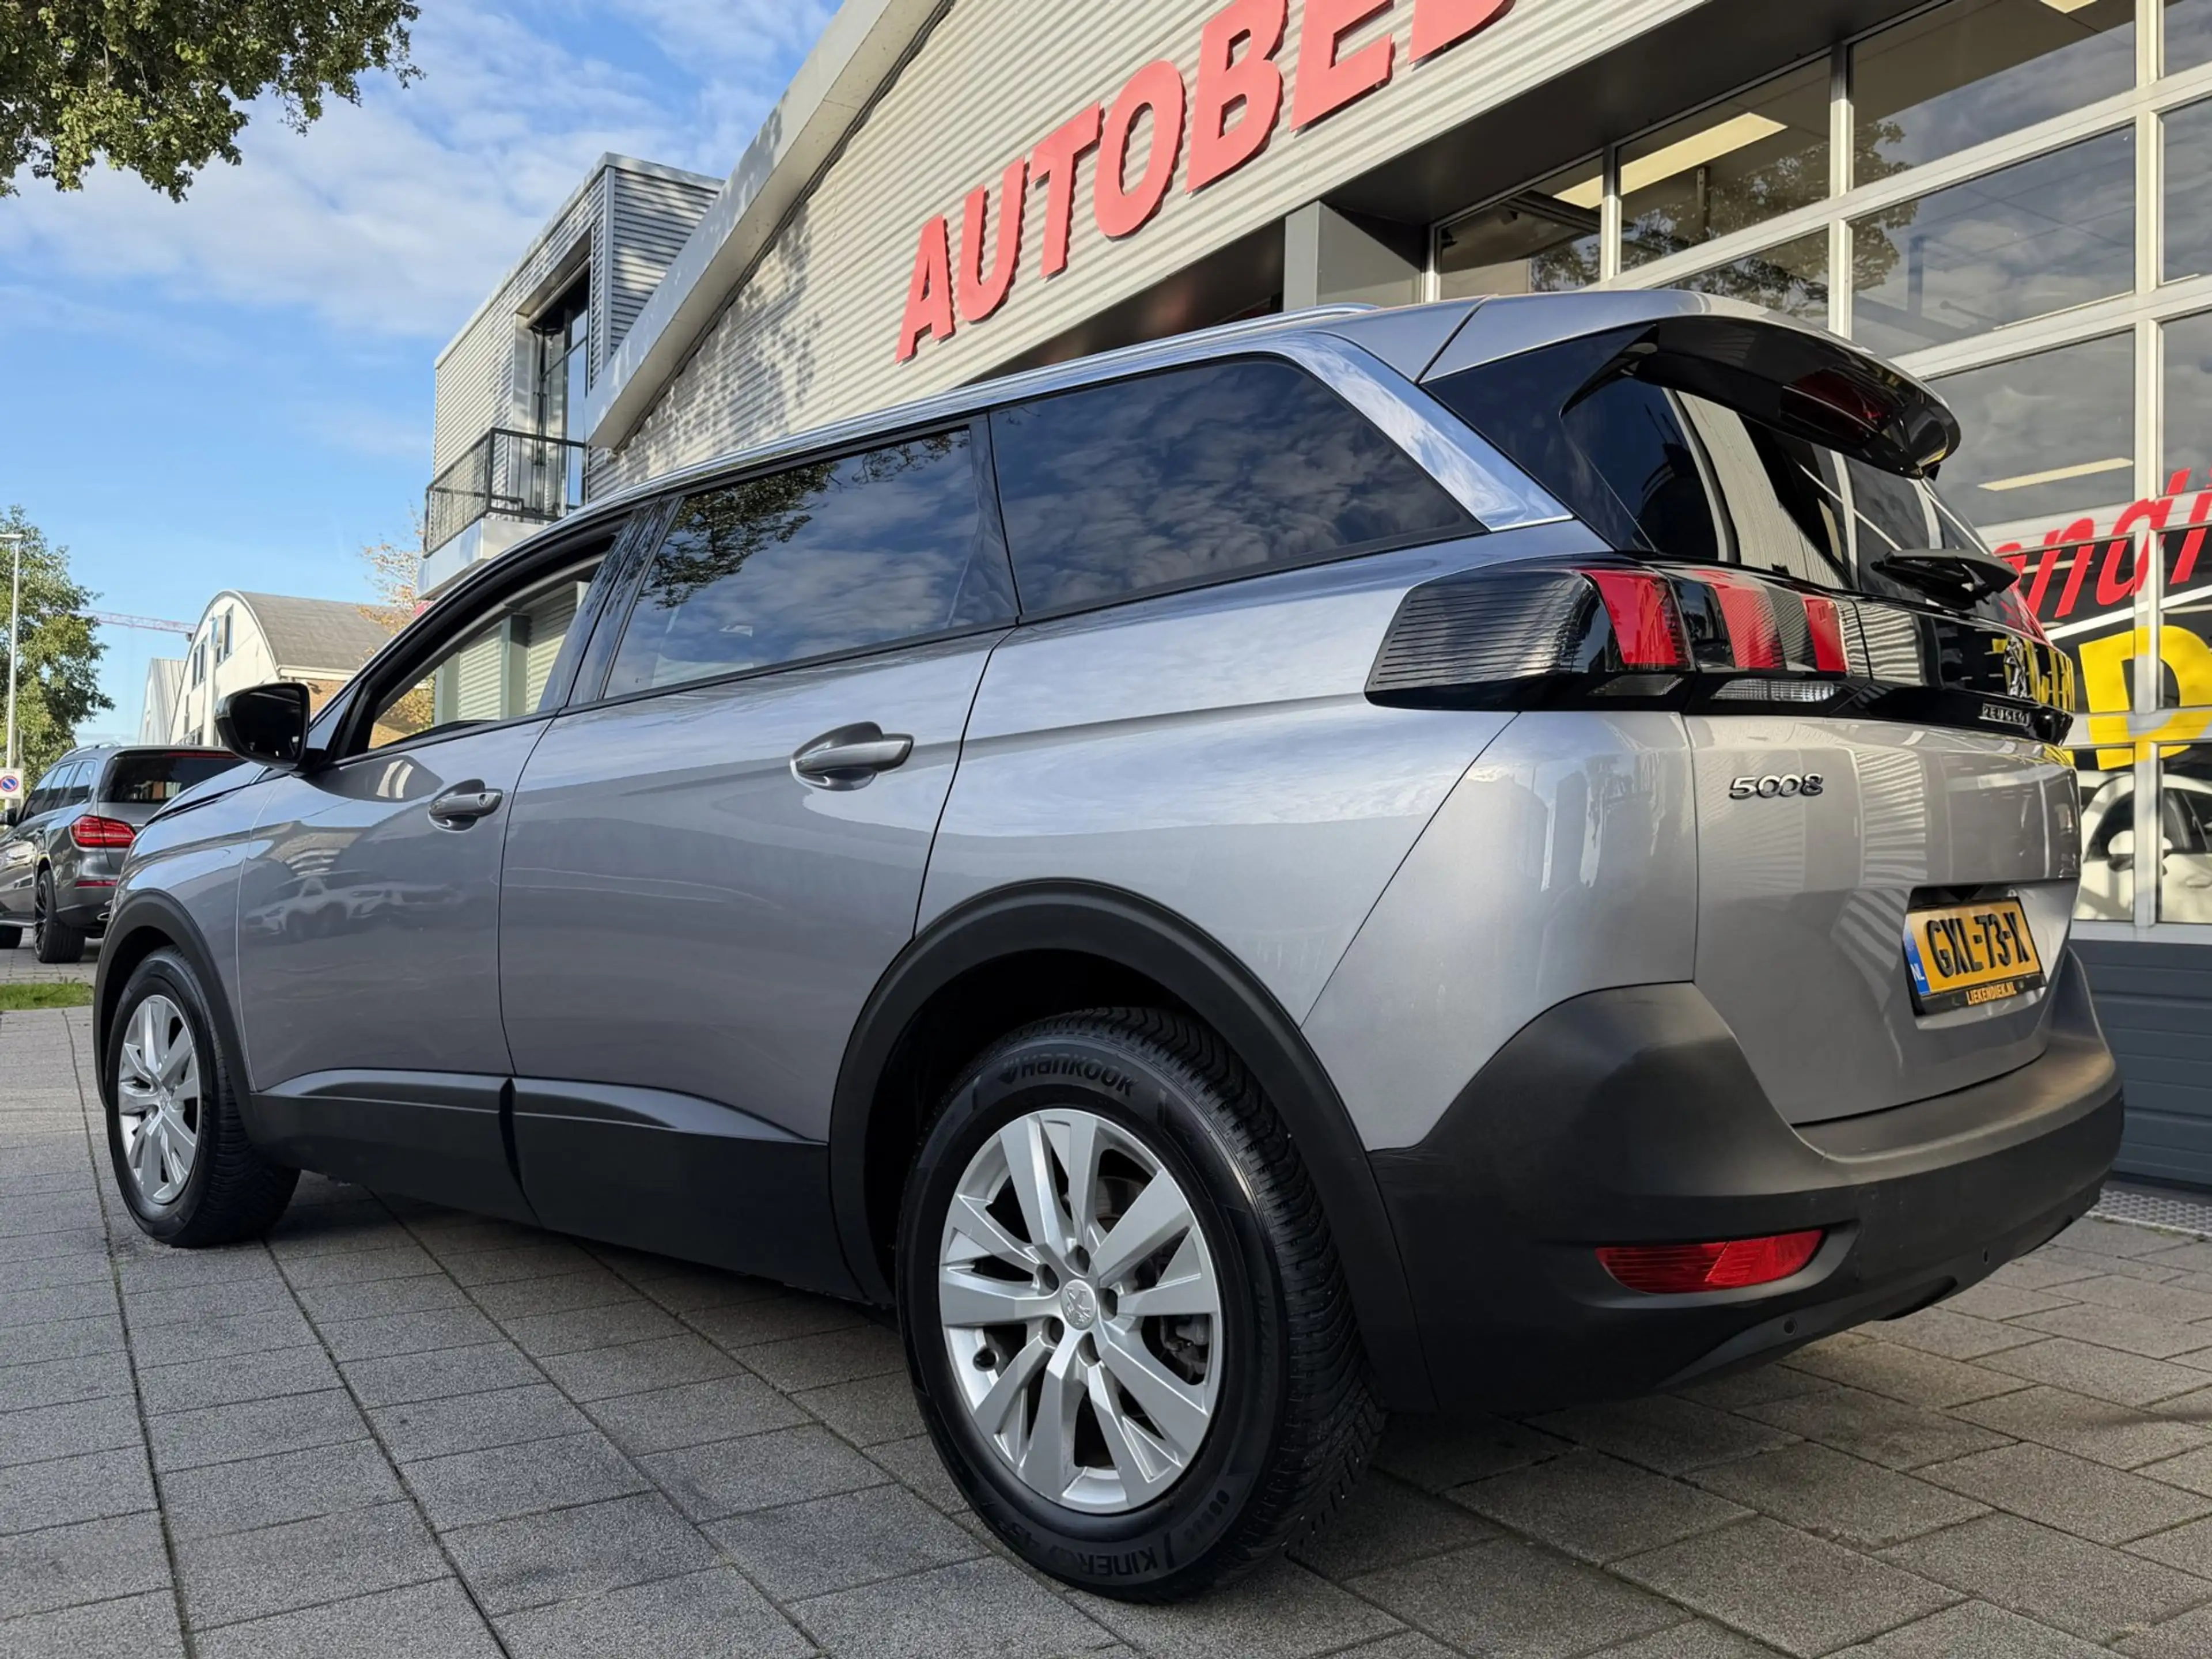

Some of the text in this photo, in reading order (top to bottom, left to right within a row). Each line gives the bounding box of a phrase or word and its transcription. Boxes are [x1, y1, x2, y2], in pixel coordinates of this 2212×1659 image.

[896, 0, 1509, 364] AUTOBE
[1729, 773, 1823, 800] 5008
[1926, 912, 2030, 978] GXL-73-X
